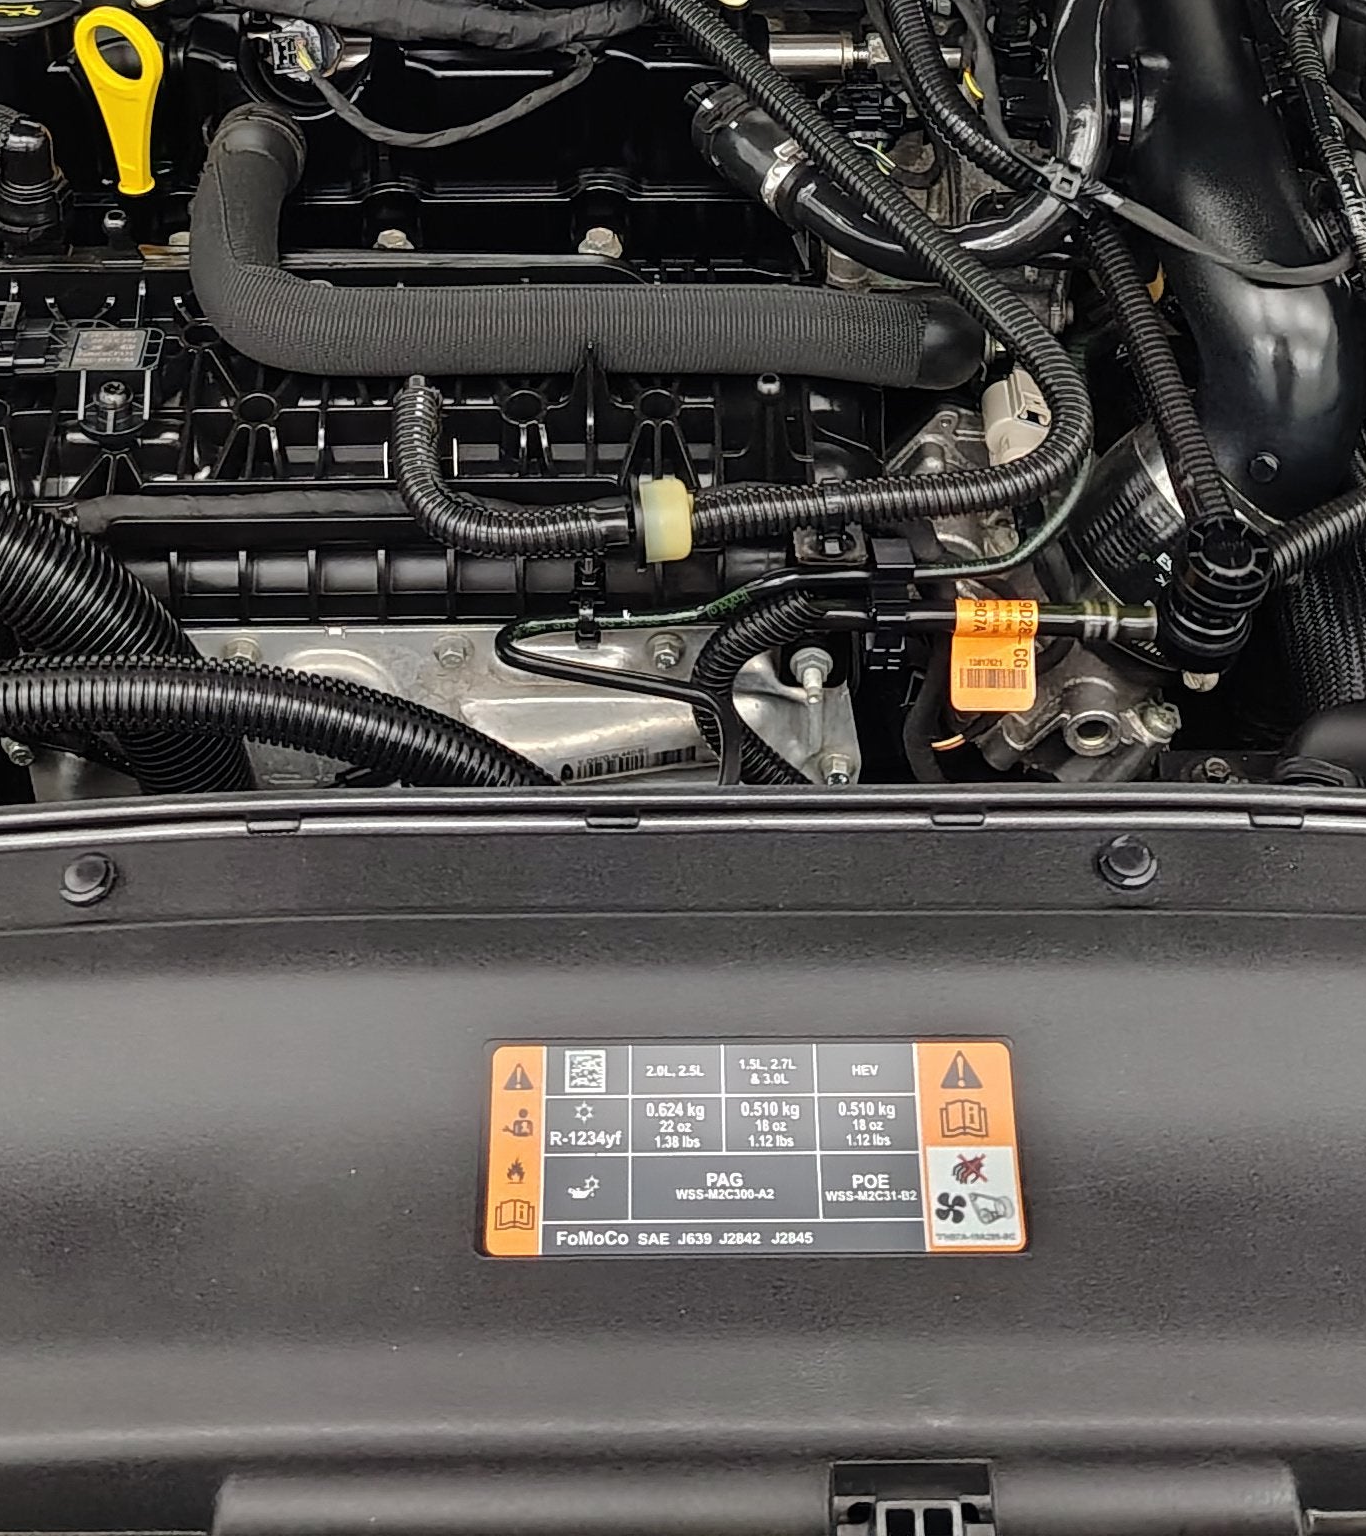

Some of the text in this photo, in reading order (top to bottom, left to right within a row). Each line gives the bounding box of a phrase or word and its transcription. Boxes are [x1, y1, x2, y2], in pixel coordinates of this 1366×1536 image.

[739, 1058, 797, 1071] 1.5L, 2.7L
[851, 1064, 879, 1076] HEV
[645, 1065, 705, 1078] 2.0L, 2.5L
[750, 1073, 790, 1085] & 3.0L
[646, 1102, 705, 1120] 0.624 kg
[740, 1101, 800, 1119] 0.510 kg
[838, 1101, 896, 1119] 0.510 kg
[659, 1120, 692, 1133] 22 oz
[755, 1119, 788, 1132] 18 oz
[852, 1119, 885, 1131] 18 oz
[549, 1130, 622, 1149] R-1234yf
[654, 1135, 701, 1149] 1.38 lbs
[748, 1135, 795, 1147] 1.12 lbs
[846, 1133, 892, 1146] 1.12 lbs
[706, 1172, 744, 1187] PAG
[851, 1173, 890, 1189] POE
[675, 1189, 775, 1200] WSS-M2C300-A2
[556, 1230, 814, 1246] FoMoCo SAE J639 J2842 J2845
